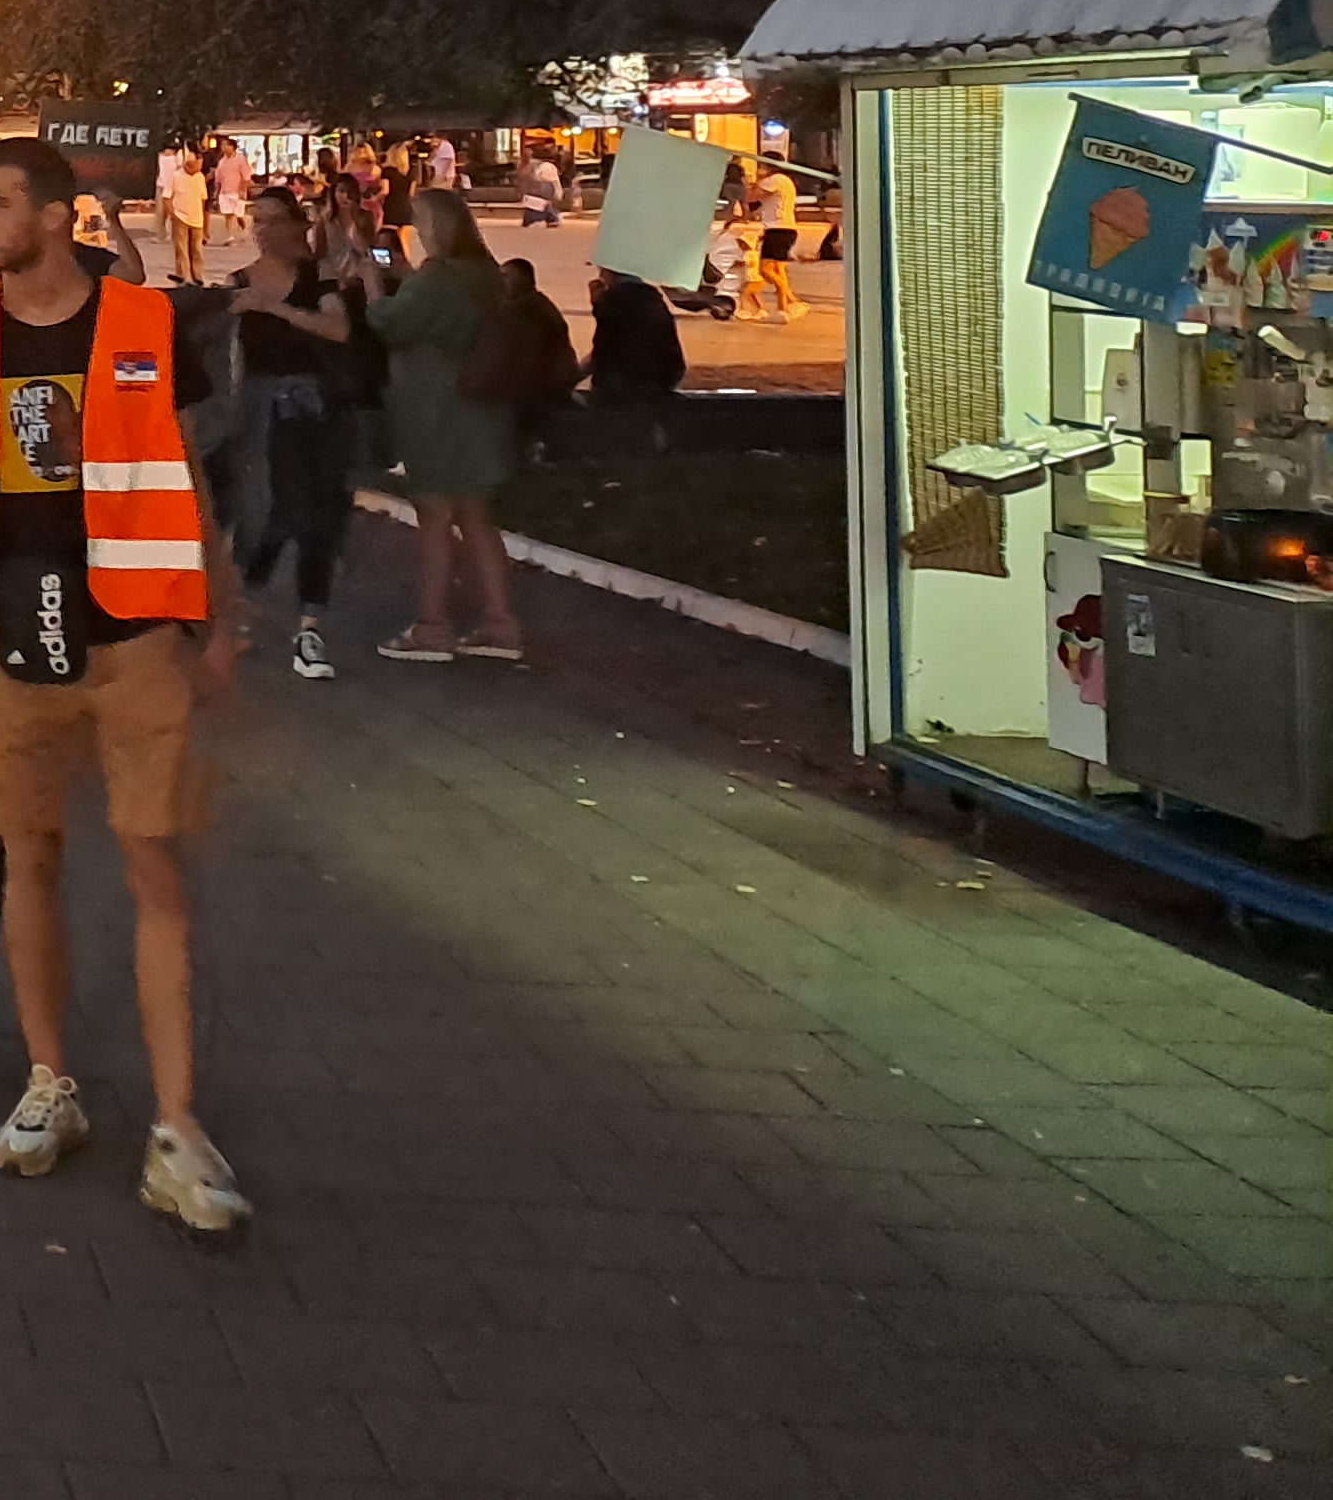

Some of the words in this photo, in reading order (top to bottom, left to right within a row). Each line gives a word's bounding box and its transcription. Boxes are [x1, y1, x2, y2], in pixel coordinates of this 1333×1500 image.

[47, 122, 90, 145] ГДЕ
[1086, 141, 1188, 180] ПЕЛИВАН
[36, 573, 71, 675] adidas
